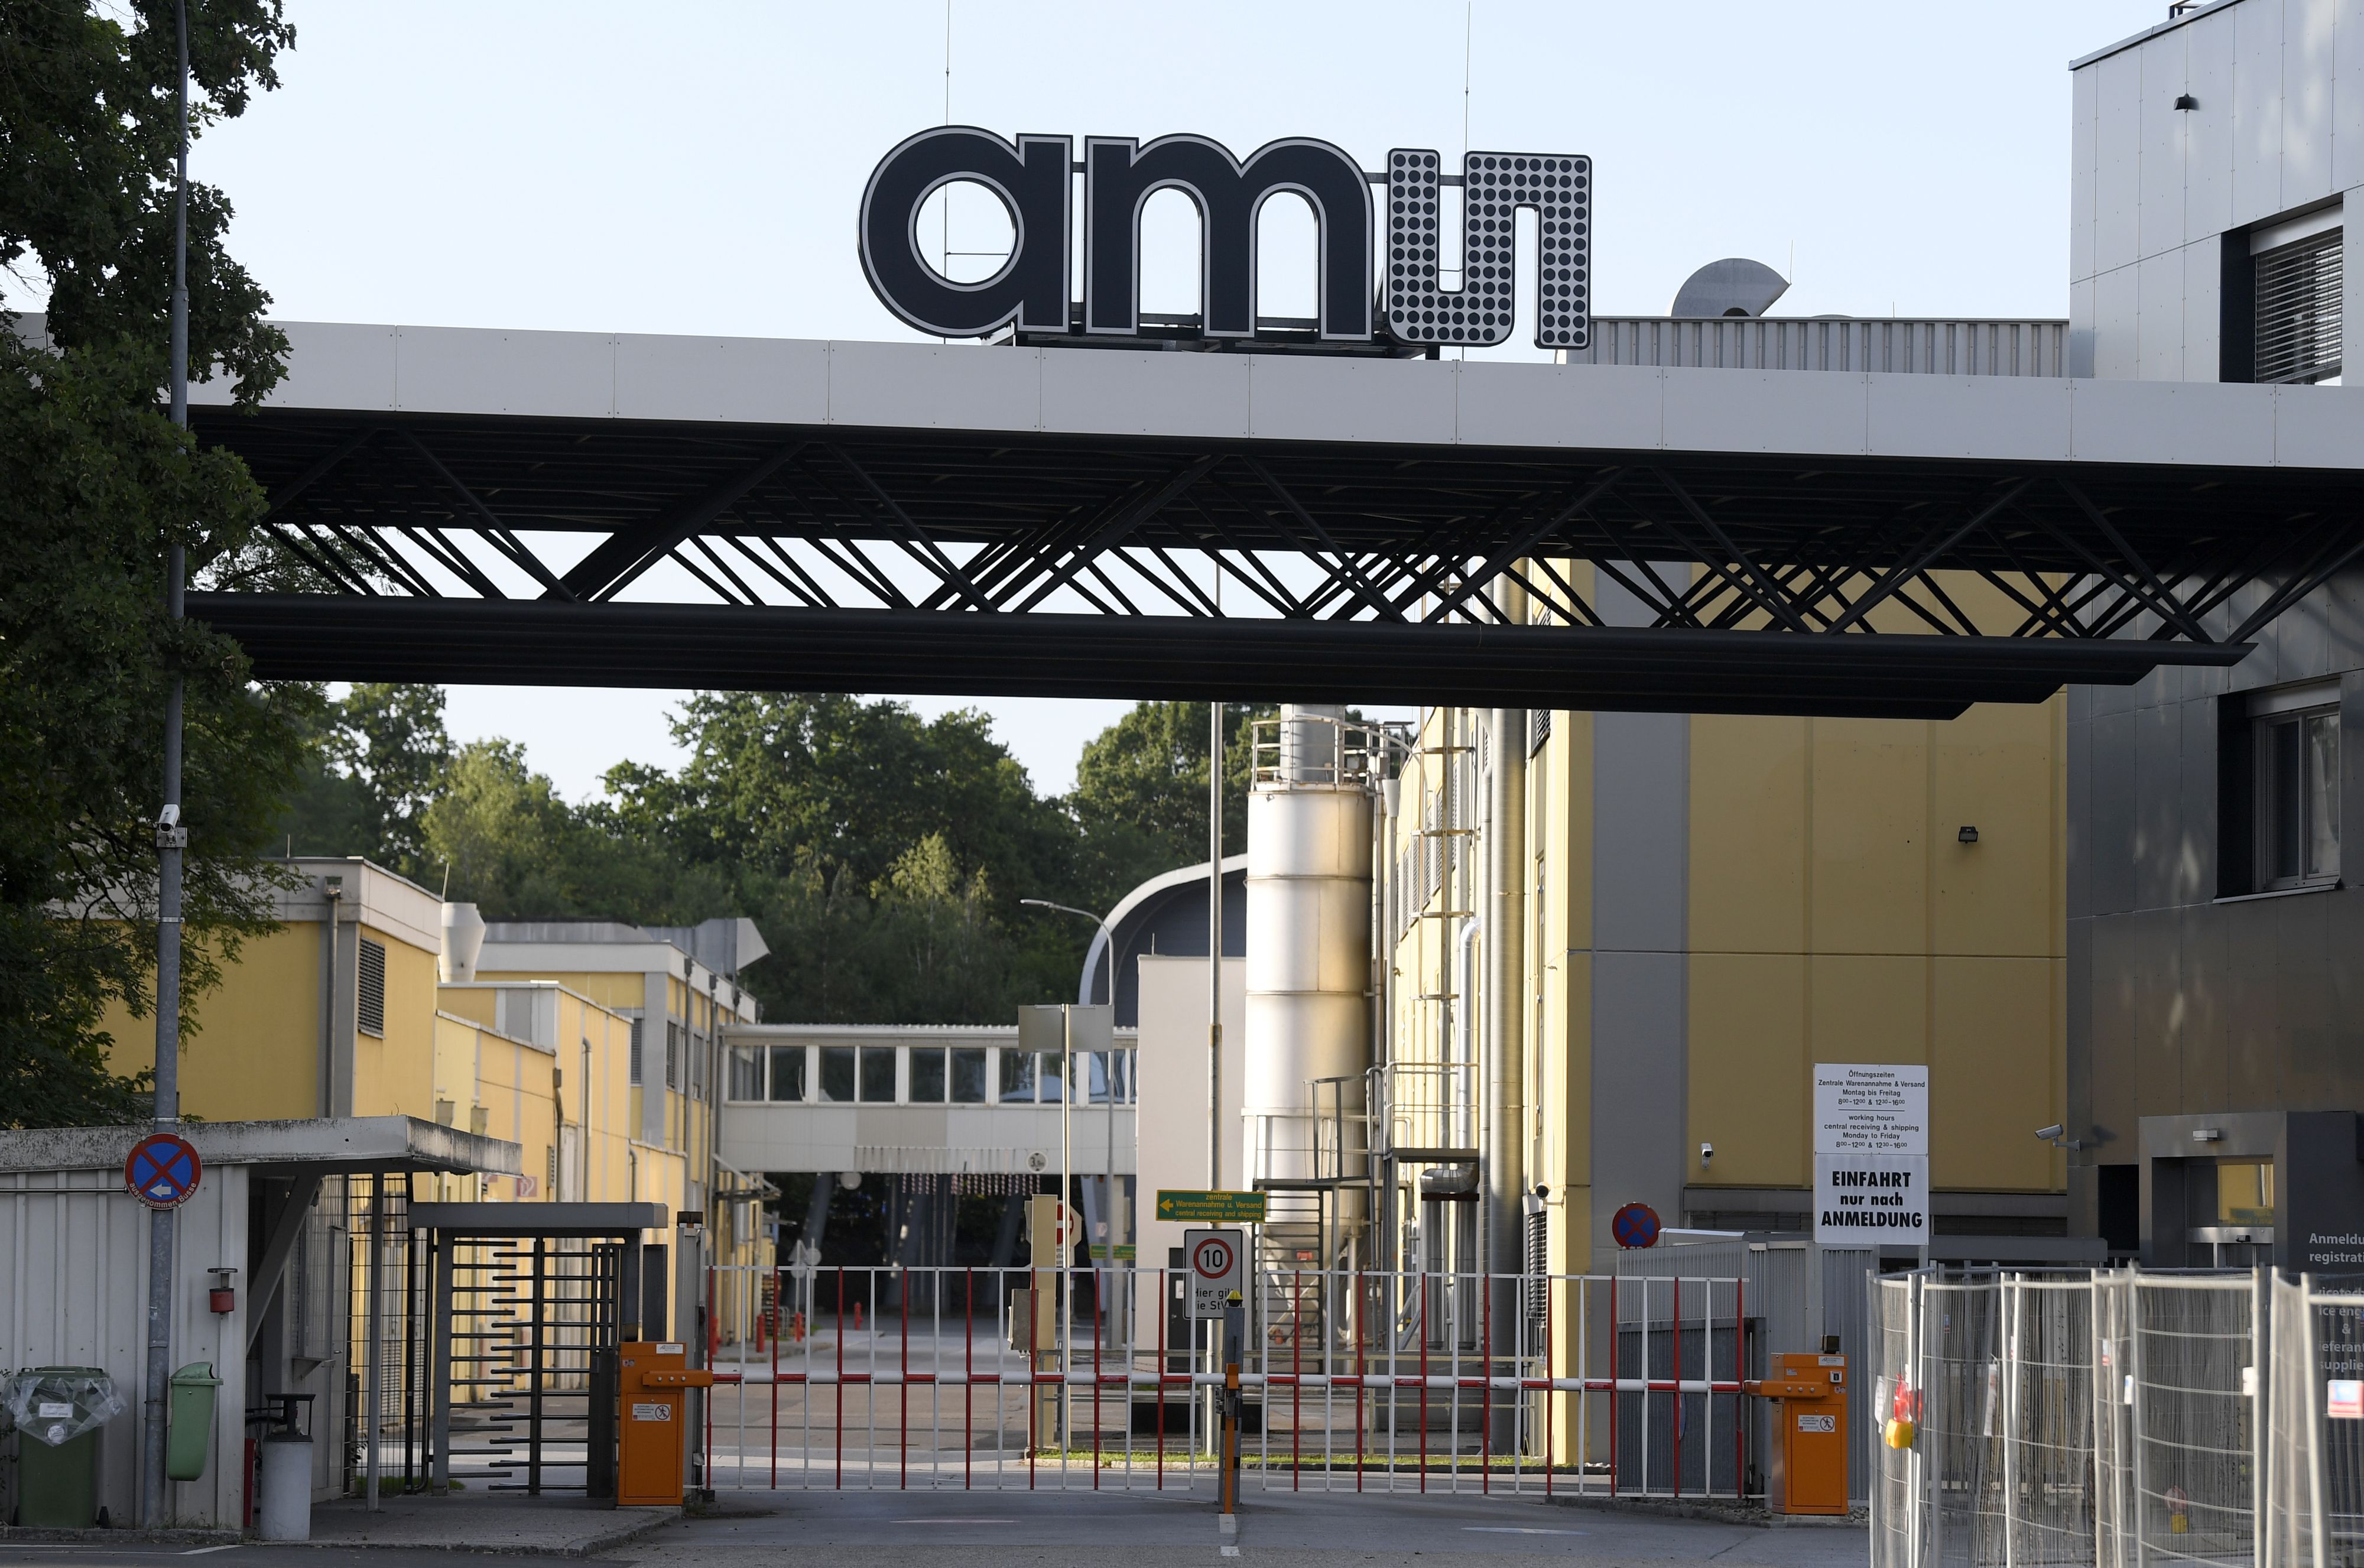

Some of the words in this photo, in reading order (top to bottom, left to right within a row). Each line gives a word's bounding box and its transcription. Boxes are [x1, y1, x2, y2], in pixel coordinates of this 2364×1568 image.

[1849, 1069, 1895, 1079] Öffnungszeiten
[1832, 1171, 1911, 1187] EINFAHRT
[129, 1183, 177, 1208] ausgenommen
[178, 1183, 197, 1203] Busse
[1840, 1195, 1865, 1205] nur
[1871, 1192, 1903, 1206] nach
[1821, 1211, 1923, 1228] ANMELDUNG
[1204, 1249, 1223, 1268] 10
[1218, 1288, 1234, 1300] gil
[2342, 1323, 2351, 1334] &
